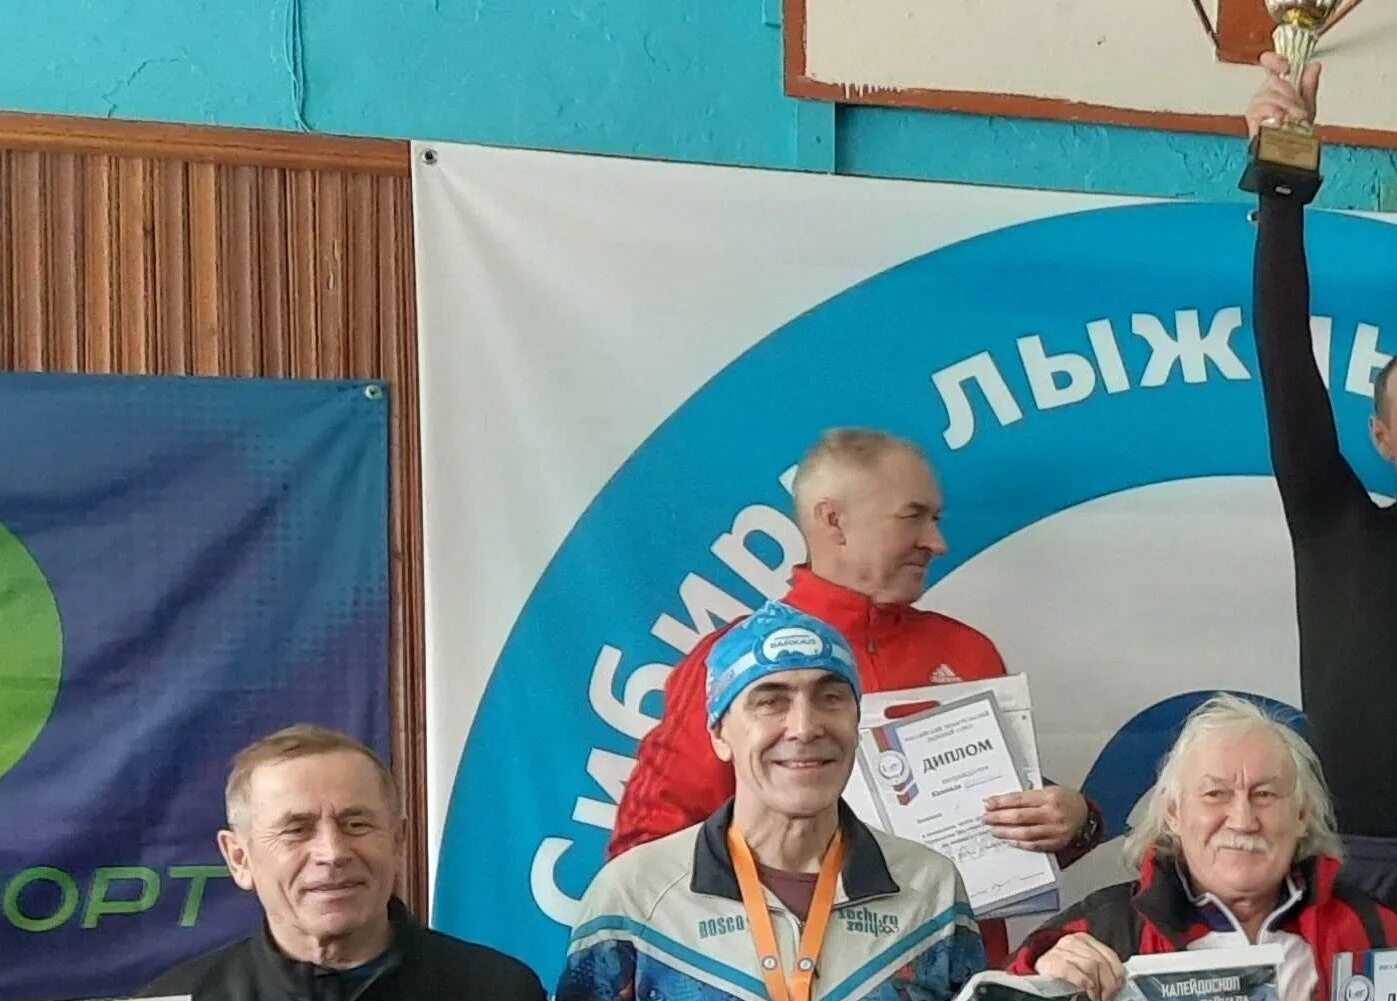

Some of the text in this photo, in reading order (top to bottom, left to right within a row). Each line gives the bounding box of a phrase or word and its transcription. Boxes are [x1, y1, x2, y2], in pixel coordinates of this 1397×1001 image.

[529, 463, 812, 930] Сибир
[921, 737, 995, 774] ДИПЛОМ
[1161, 975, 1242, 998] КАЛЕЙДОСКОП
